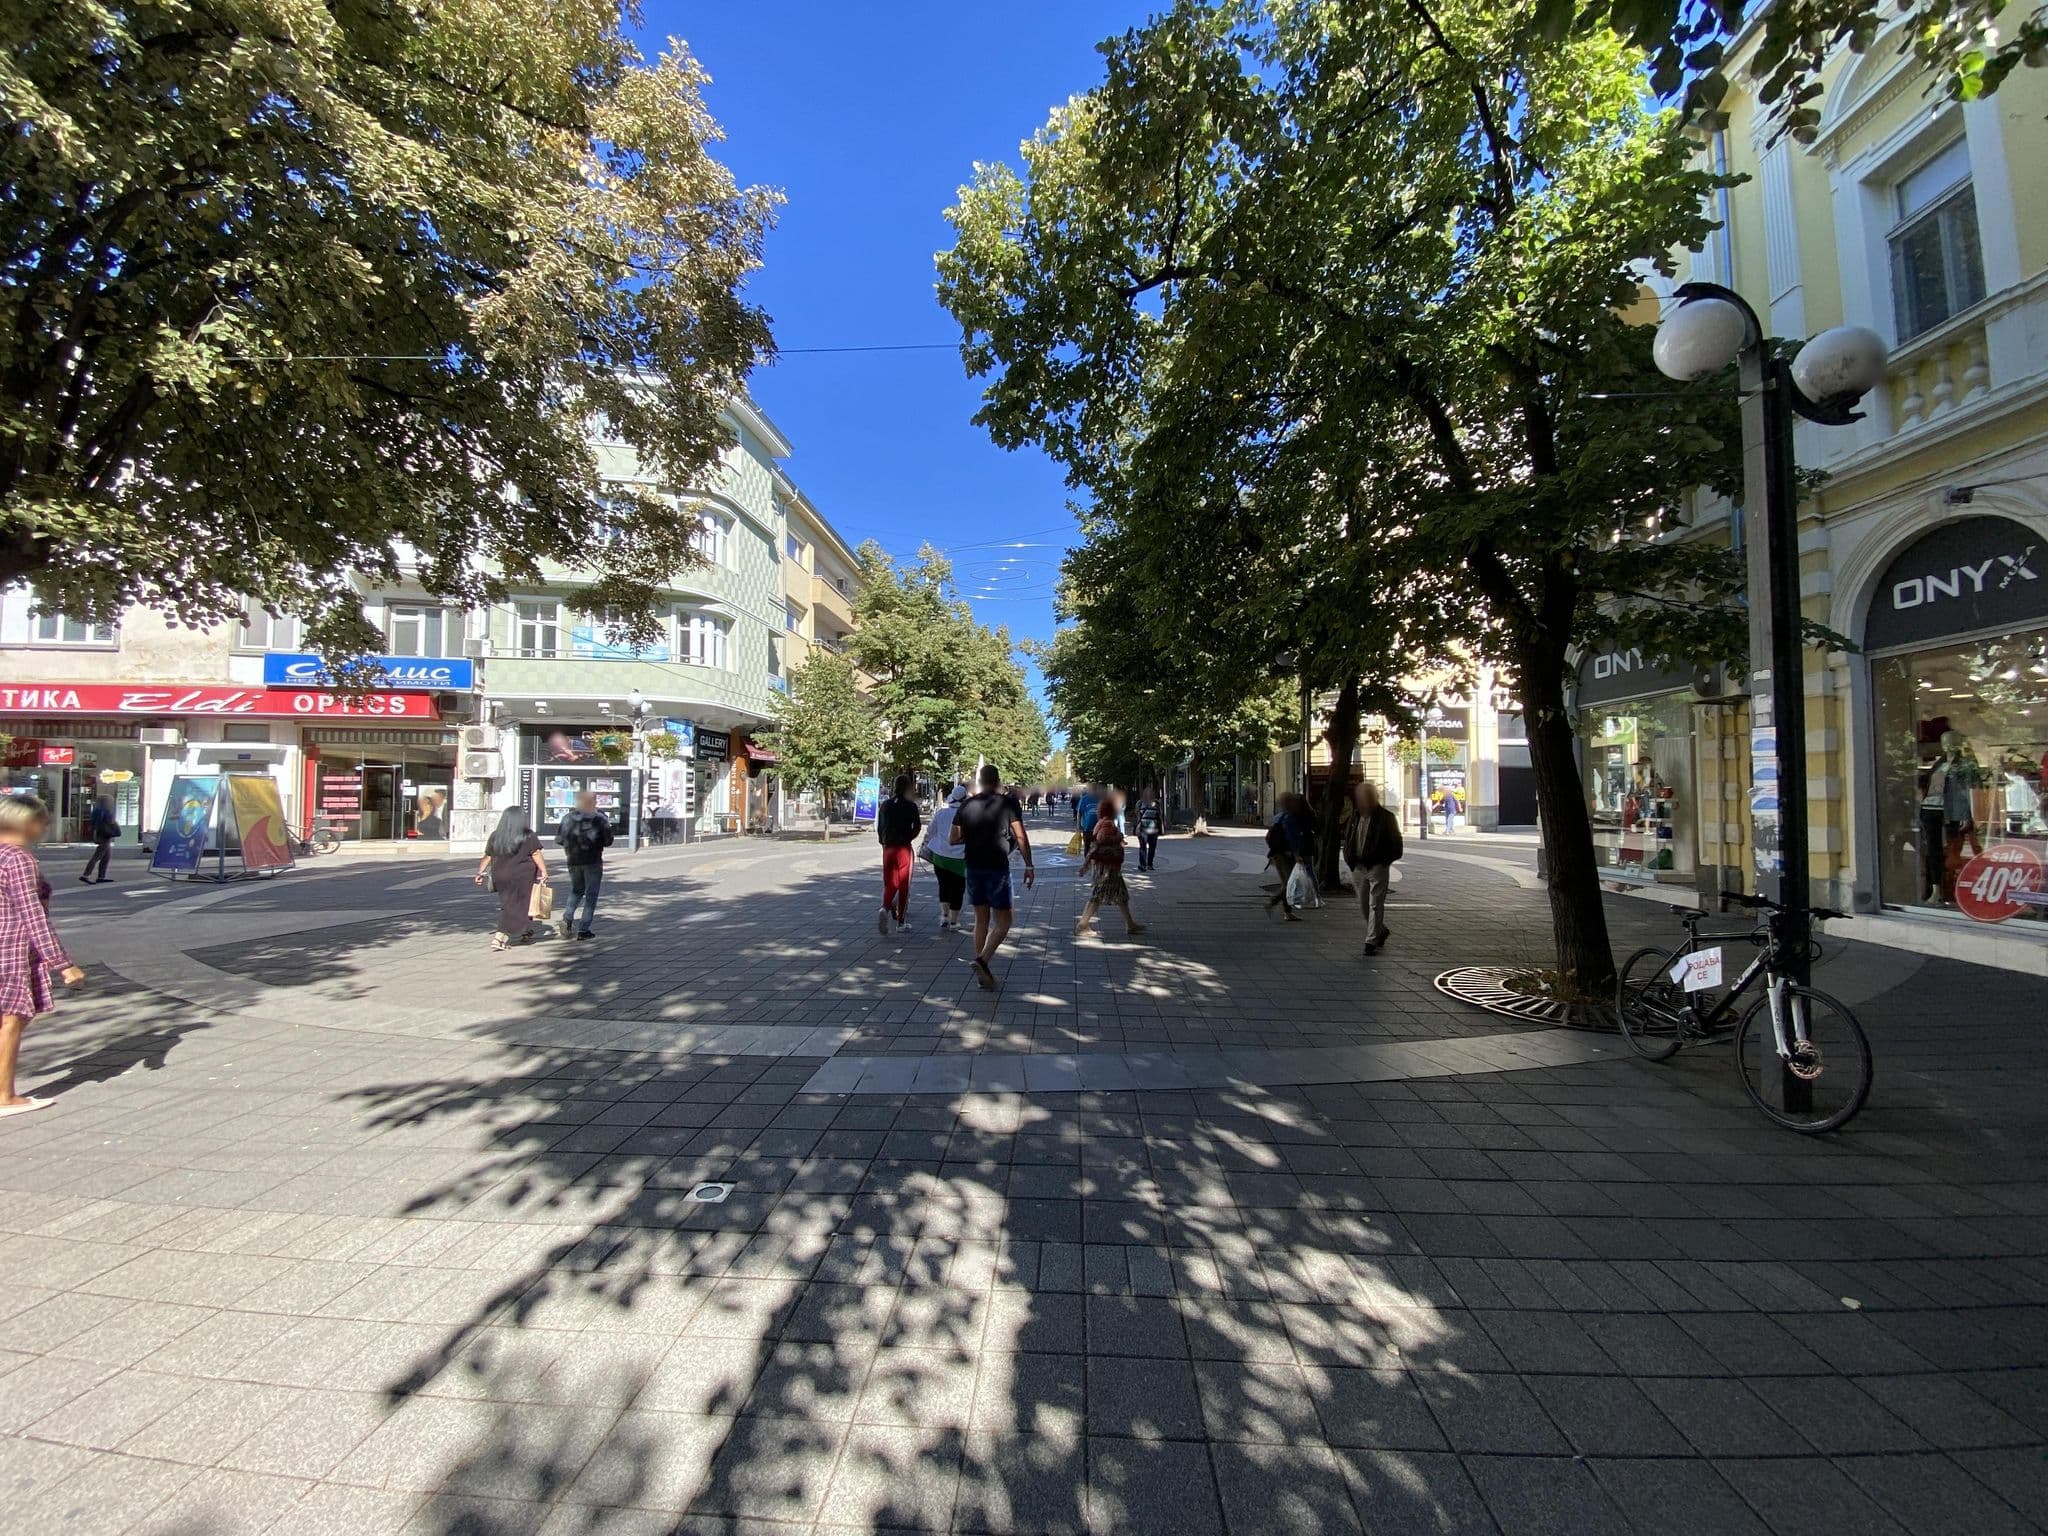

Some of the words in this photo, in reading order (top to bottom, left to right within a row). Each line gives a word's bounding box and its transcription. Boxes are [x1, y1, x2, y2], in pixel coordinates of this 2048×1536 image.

[1893, 555, 2039, 610] ONYX
[1, 689, 81, 709] ТИКА
[119, 690, 264, 712] Eldi
[700, 735, 726, 750] GALLERY
[1989, 849, 2025, 864] sale
[1688, 956, 1720, 970] РОДАВА
[1697, 970, 1708, 980] СЕ
